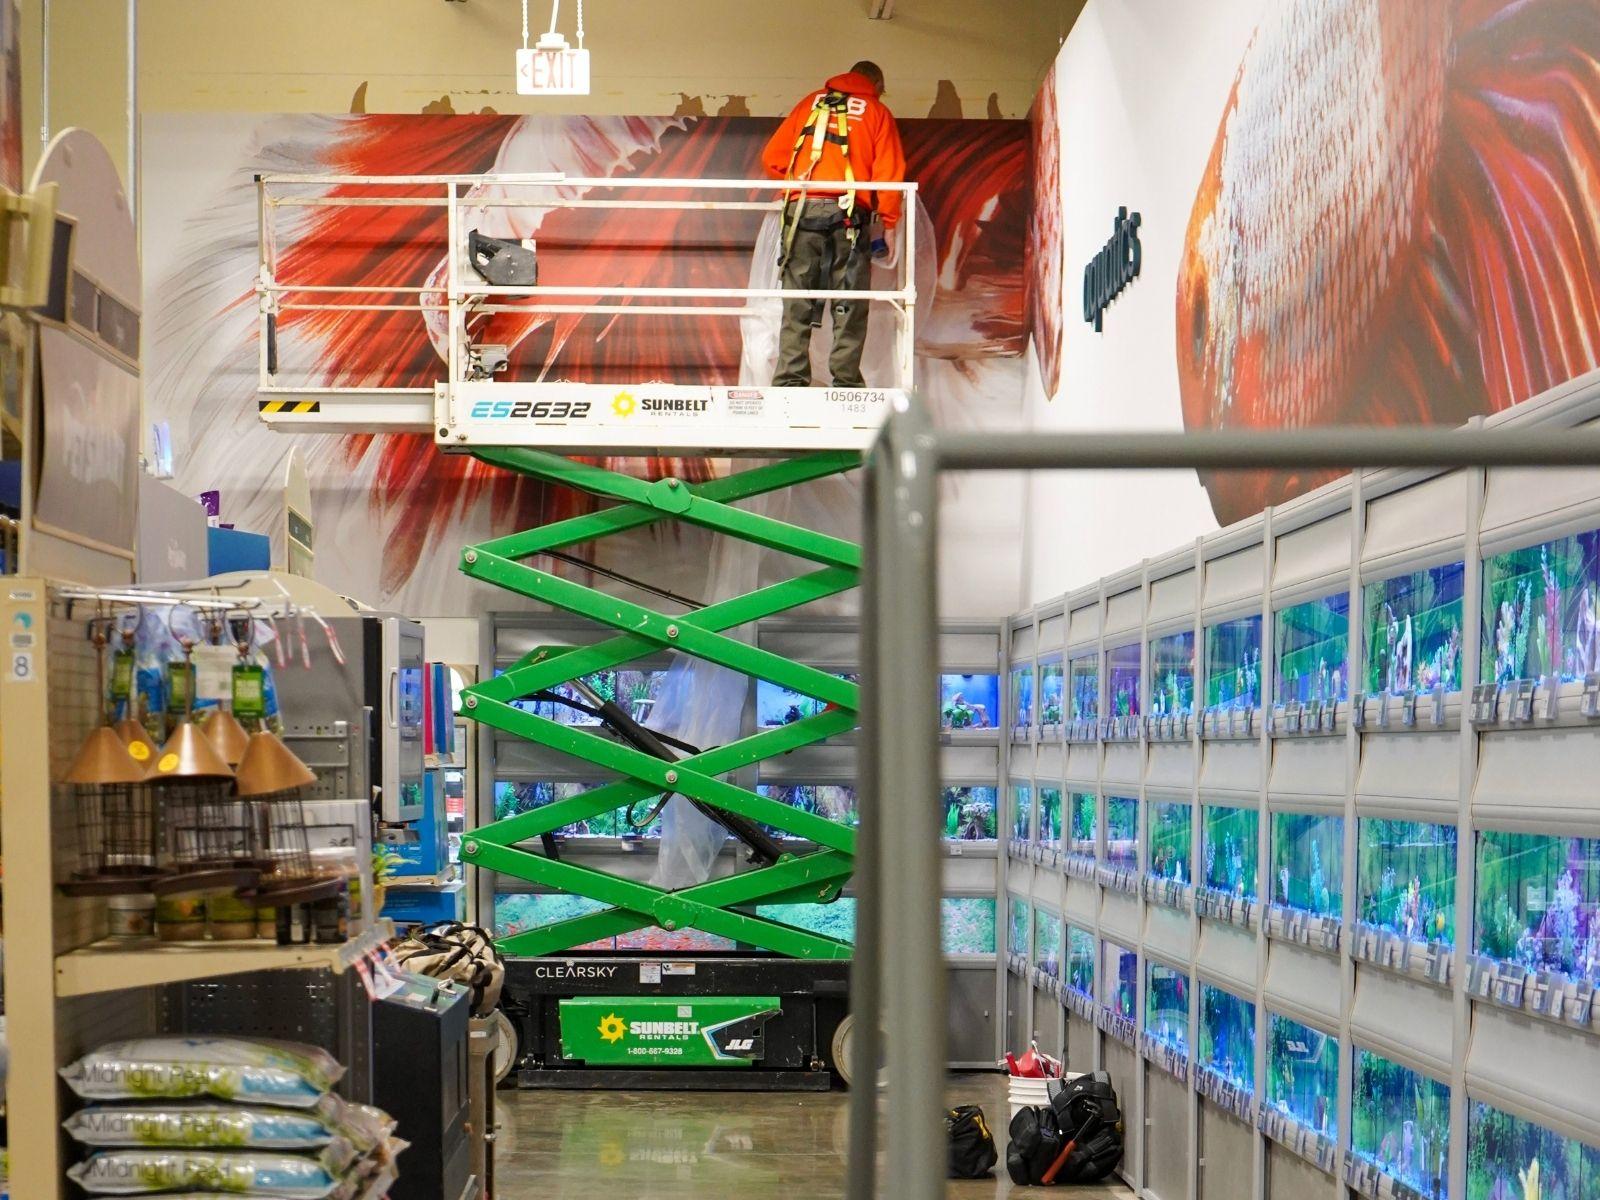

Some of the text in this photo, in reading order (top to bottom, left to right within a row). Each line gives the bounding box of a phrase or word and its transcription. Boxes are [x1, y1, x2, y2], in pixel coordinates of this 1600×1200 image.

[531, 52, 577, 89] EXIT
[824, 391, 886, 403] 10506734
[470, 401, 592, 419] ES2632
[641, 398, 708, 412] SUNBELT
[841, 403, 866, 413] 1483
[14, 655, 29, 677] 8
[535, 966, 617, 978] CLEARSKY
[630, 1021, 699, 1035] SUNBELT
[725, 1039, 754, 1051] JLG
